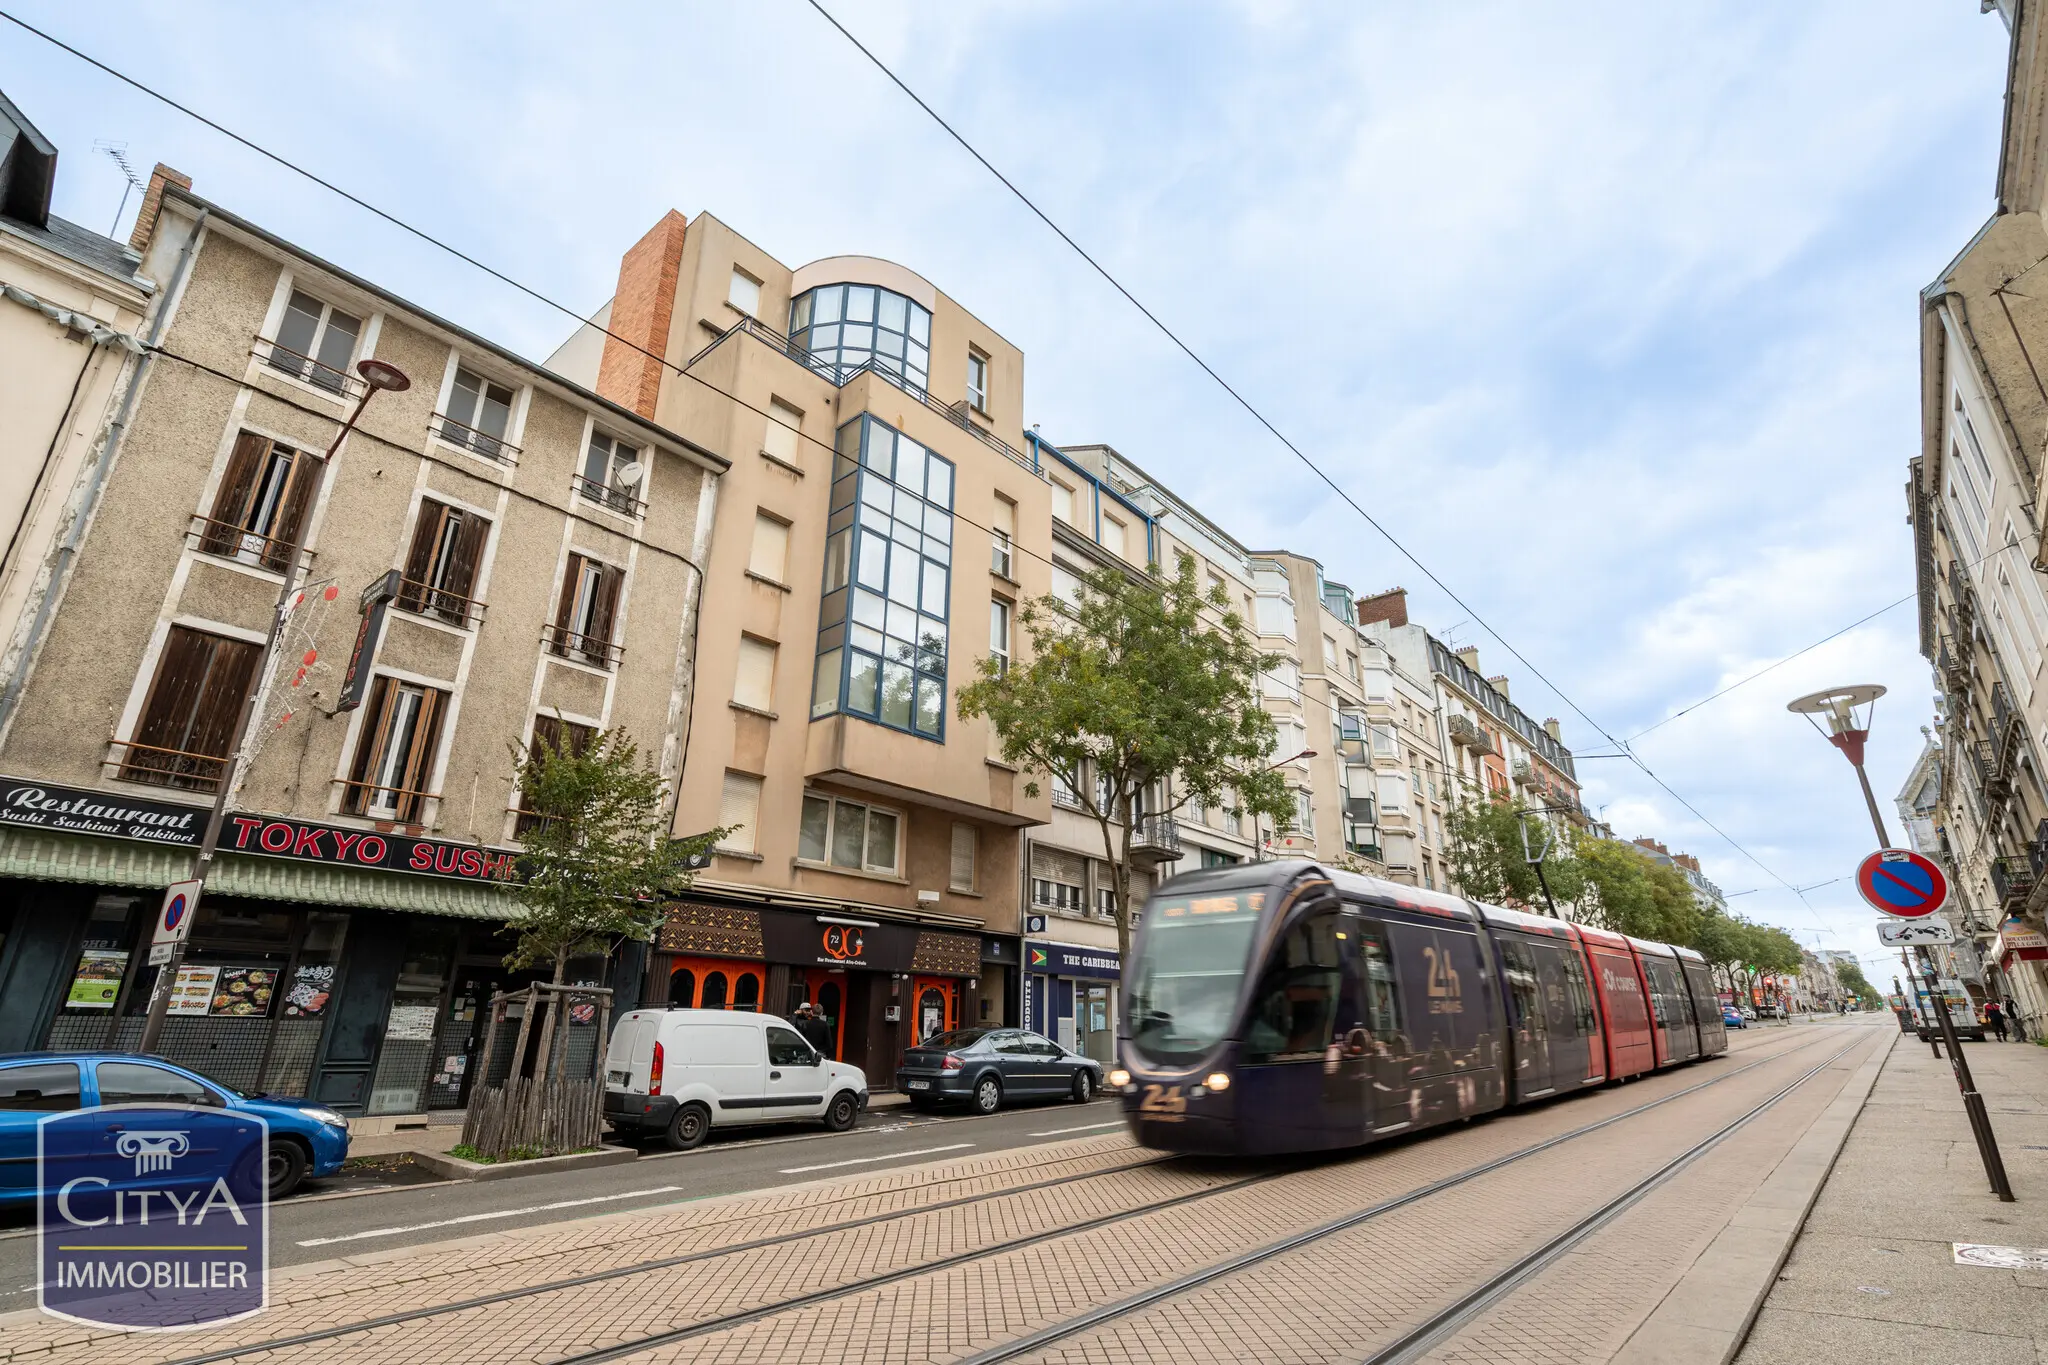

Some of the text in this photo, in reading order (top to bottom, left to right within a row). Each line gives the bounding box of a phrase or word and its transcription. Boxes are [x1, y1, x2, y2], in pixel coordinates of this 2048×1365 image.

[347, 601, 374, 681] TOKYO
[0, 808, 197, 844] Sushi Sashimi Yakitori
[6, 787, 194, 830] Restaurant
[232, 817, 514, 880] TOKYO SUSHI
[822, 924, 864, 960] QG
[830, 934, 839, 944] 72
[824, 957, 846, 965] Restaurant
[1063, 954, 1080, 965] THE
